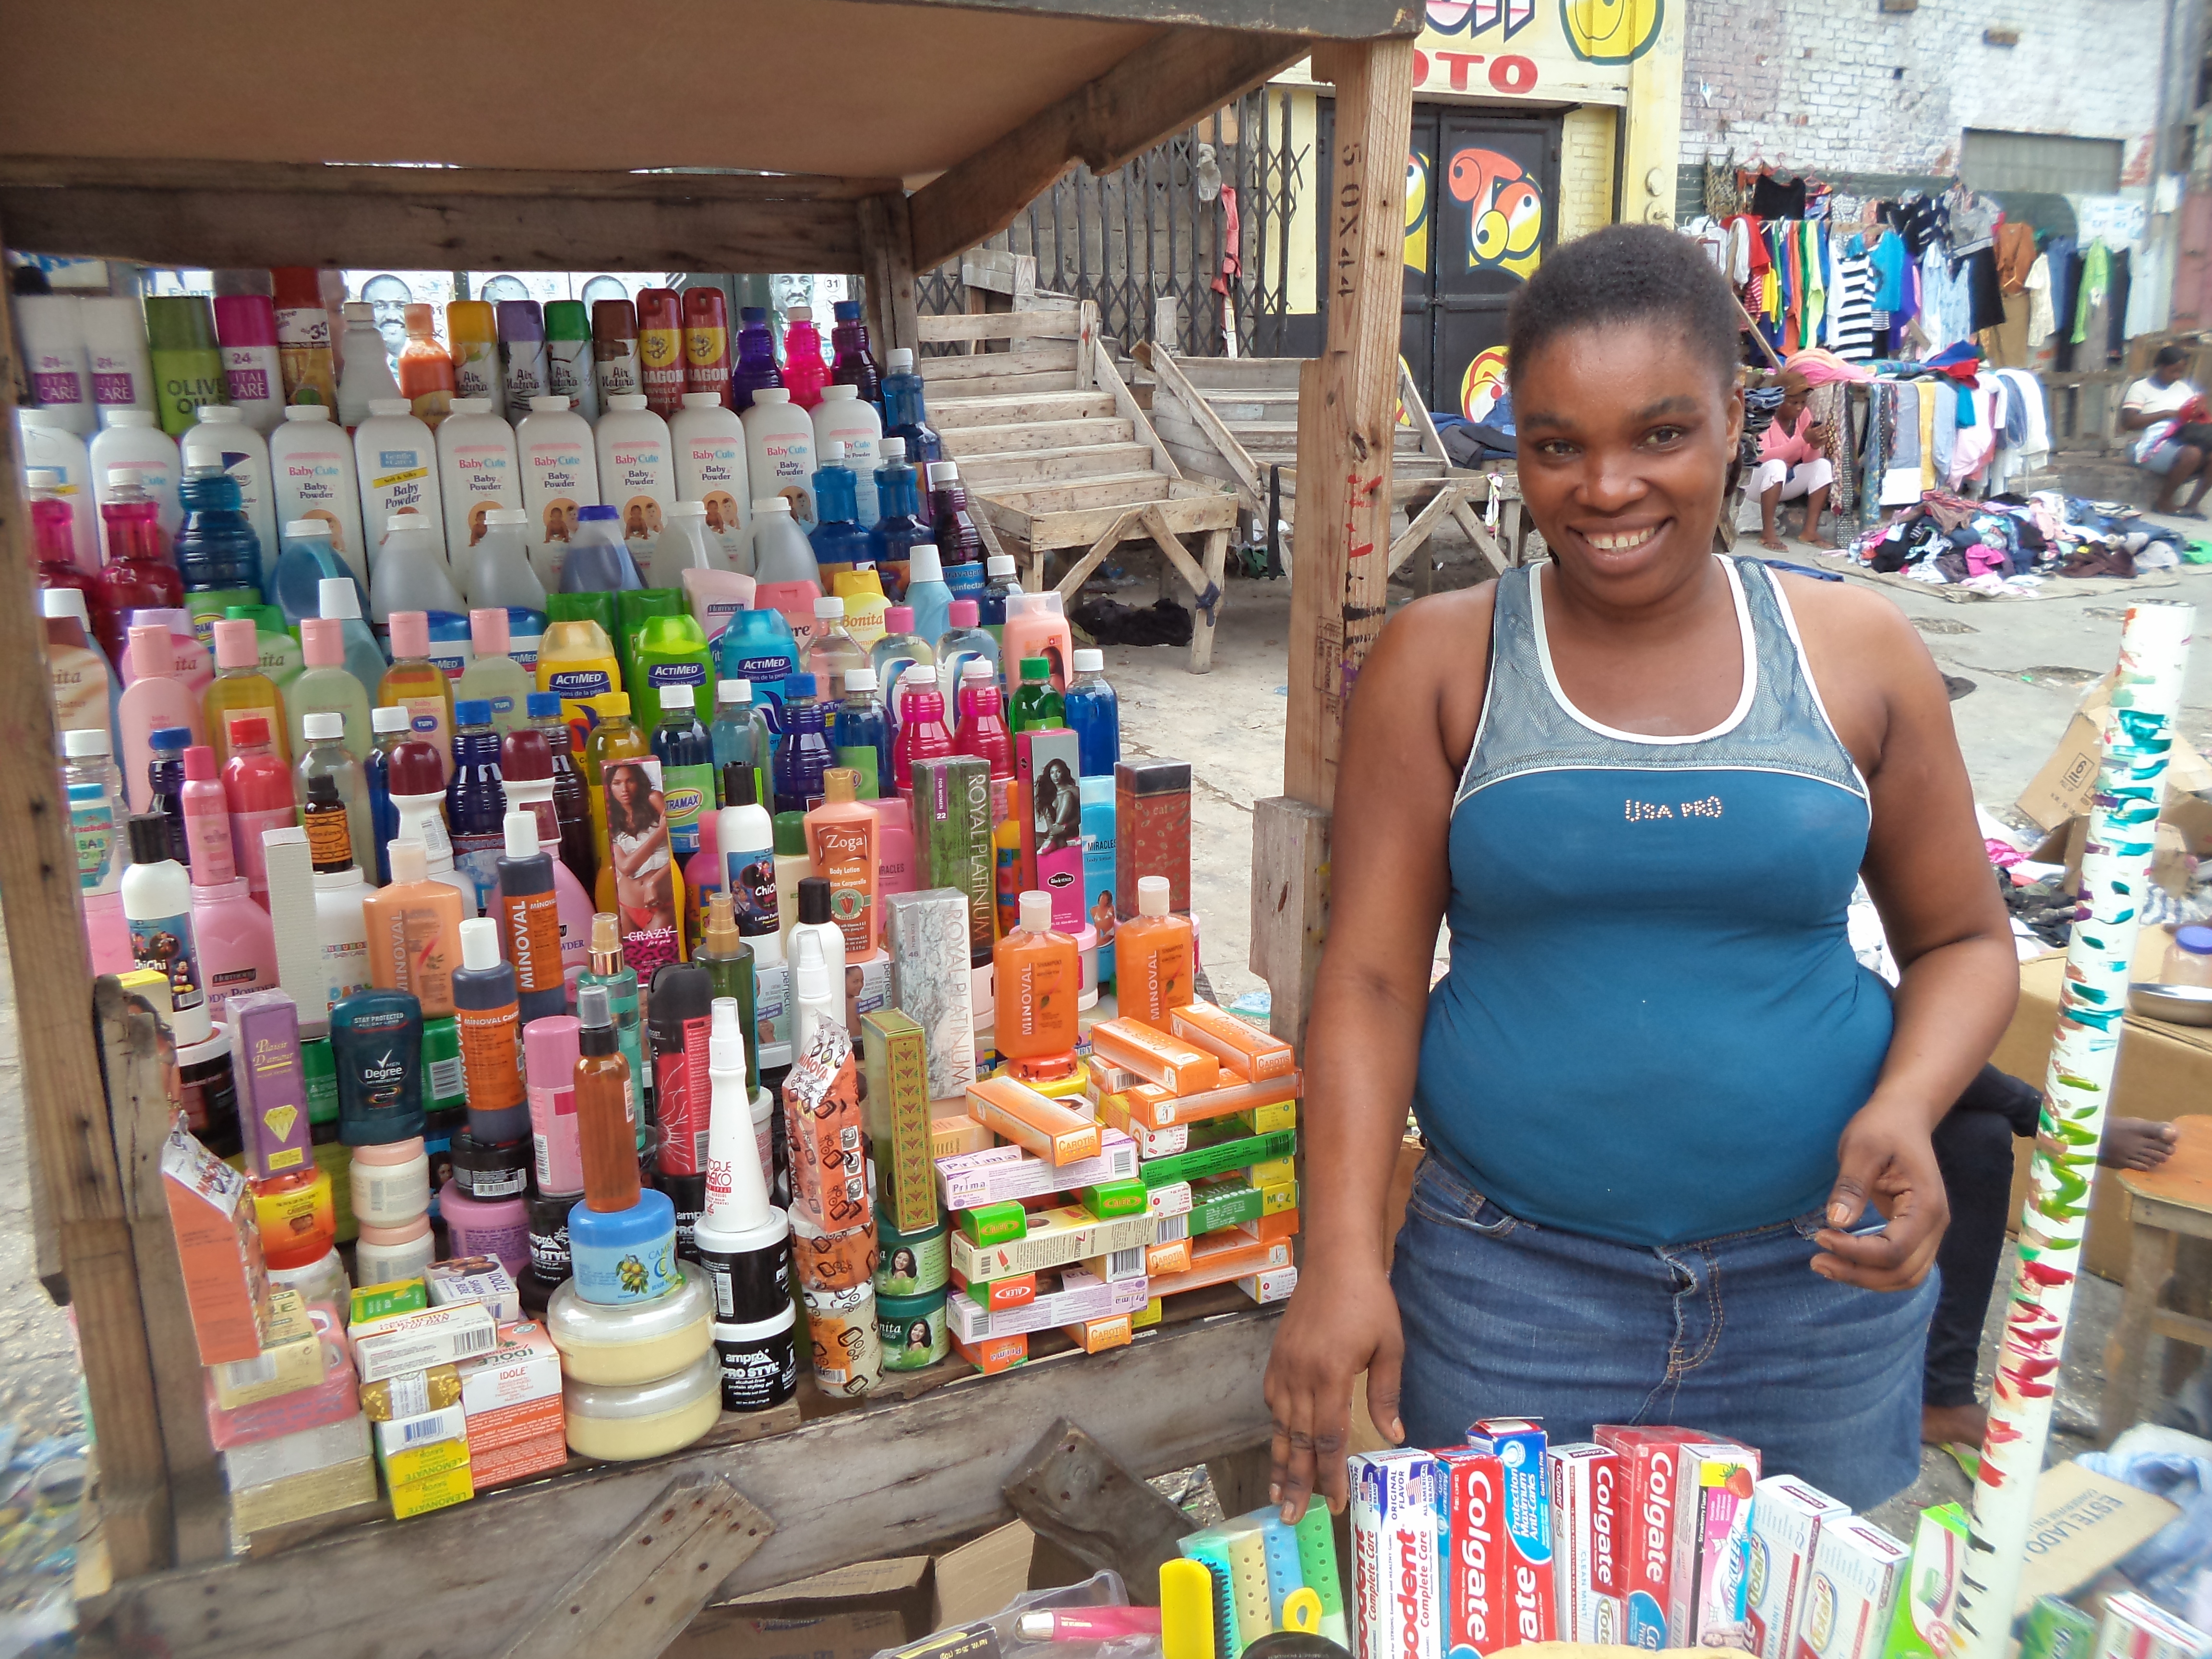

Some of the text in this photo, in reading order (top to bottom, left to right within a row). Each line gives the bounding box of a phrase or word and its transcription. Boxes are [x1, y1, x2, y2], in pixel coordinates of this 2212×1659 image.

[827, 279, 838, 288] 31
[232, 352, 251, 364] 24
[464, 371, 481, 382] Air
[517, 368, 533, 380] Air
[555, 366, 573, 378] Air
[613, 366, 629, 378] Air
[506, 379, 540, 391] Natura
[602, 376, 635, 388] Natura
[41, 387, 78, 401] CARE
[97, 387, 131, 400] CARE
[230, 383, 267, 398] CARE
[705, 465, 727, 475] Baby
[776, 468, 804, 477] Powder
[780, 461, 800, 471] Baby
[474, 474, 496, 483] Baby
[548, 471, 570, 481] Baby
[628, 469, 649, 480] Baby
[702, 473, 732, 482] Powder
[303, 482, 327, 492] Baby
[470, 483, 502, 491] Powder
[544, 480, 576, 488] Powder
[625, 478, 654, 486] Powder
[300, 491, 334, 500] Powder
[394, 482, 420, 497] Baby
[385, 493, 421, 509] Powder
[844, 612, 883, 627] Bonita
[1625, 795, 1722, 822] USA PRO
[826, 835, 864, 852] Zoga
[1087, 839, 1116, 852] MIRACLES
[968, 774, 990, 941] ROYAL PLATINUM
[830, 867, 842, 876] Body
[879, 864, 904, 875] IRACLES
[628, 925, 672, 942] CRAZY
[511, 900, 534, 989] MINOVAL
[1151, 950, 1160, 1021] MINOVAL
[944, 909, 972, 1086] ROYAL PLATINUM
[1022, 962, 1034, 1036] MINOVAL
[371, 1012, 404, 1022] PROTECTED
[464, 1016, 502, 1026] MINOVAL
[365, 1067, 403, 1079] Degree
[945, 1153, 1019, 1171] Prima
[953, 1177, 986, 1193] Prima
[487, 1272, 510, 1292] IDOLE
[1004, 1286, 1027, 1297] ALEK
[1115, 1293, 1146, 1306] Prima
[475, 1348, 534, 1367] IDOLE
[990, 1345, 1022, 1362] Prima
[500, 1367, 527, 1381] IDOLE
[721, 1367, 745, 1378] PRO
[1572, 1447, 1605, 1457] Colgate
[1555, 1464, 1563, 1508] Colgate
[1519, 1472, 1529, 1538] Maximum
[1527, 1473, 1539, 1541] Anti-Caries
[2076, 1494, 2125, 1527] ESTE
[1643, 1452, 1672, 1582] Colgate
[1593, 1466, 1614, 1585] Colgate
[1698, 1513, 1706, 1543] Strawberry
[2025, 1517, 2077, 1555] LADO
[1461, 1470, 1492, 1641] Colgate
[1366, 1530, 1379, 1622] Complete Care
[1416, 1531, 1433, 1628] Complete Care
[1598, 1600, 1612, 1645] Tota
[1771, 1605, 1780, 1631] MINT
